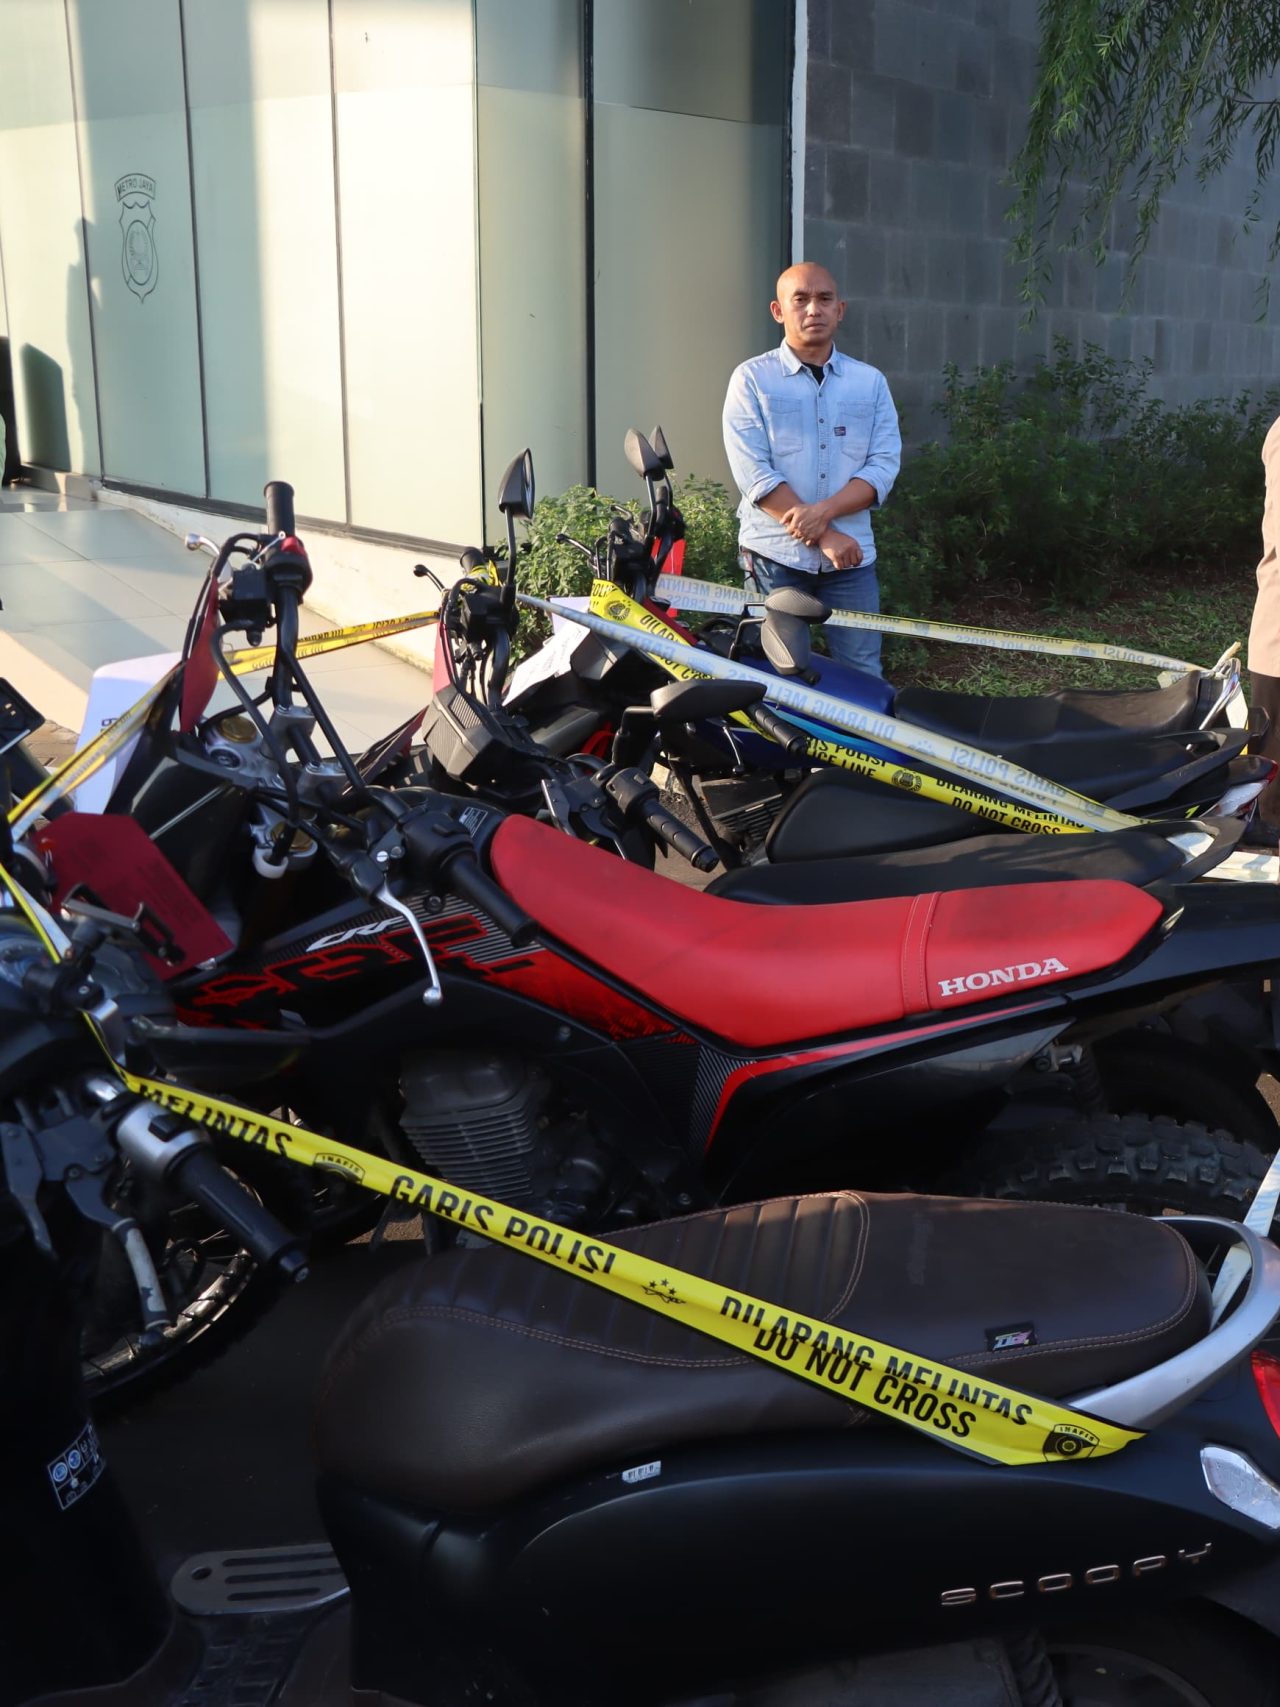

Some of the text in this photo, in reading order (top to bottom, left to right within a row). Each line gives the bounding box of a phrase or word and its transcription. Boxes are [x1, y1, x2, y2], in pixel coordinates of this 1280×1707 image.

[836, 739, 888, 769] POLISI
[951, 796, 1062, 836] DO NOT CROSS
[306, 915, 404, 952] CRF
[938, 957, 1069, 997] HONDA
[321, 1155, 361, 1174] INAFIS
[389, 1174, 617, 1275] GARIS POLISI
[719, 1295, 1033, 1426] DILARANG MELINTAS
[752, 1328, 977, 1438] DO NOT CROSS
[1058, 1426, 1097, 1442] INAFIS
[941, 1542, 1213, 1606] SCOOPY
